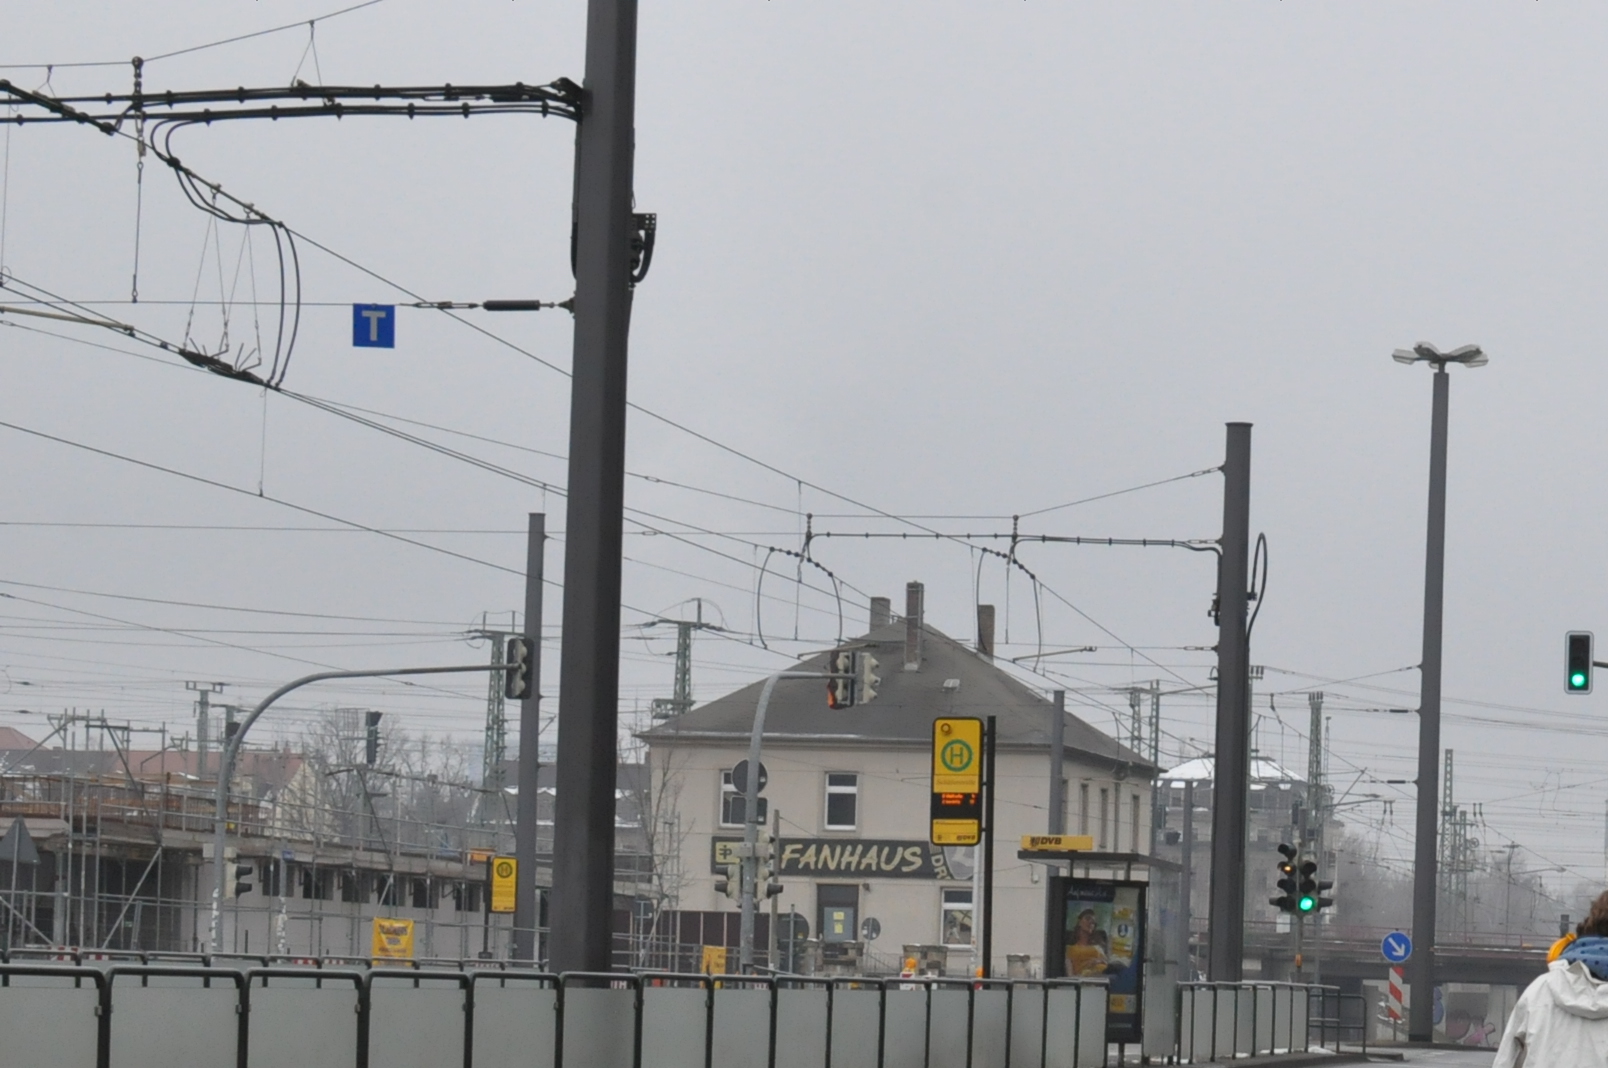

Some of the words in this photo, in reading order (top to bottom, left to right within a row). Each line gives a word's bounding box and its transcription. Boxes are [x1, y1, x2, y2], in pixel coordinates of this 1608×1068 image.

[362, 310, 386, 341] T
[950, 746, 964, 765] H
[1040, 836, 1062, 845] DVB
[781, 844, 923, 872] FANHAUS
